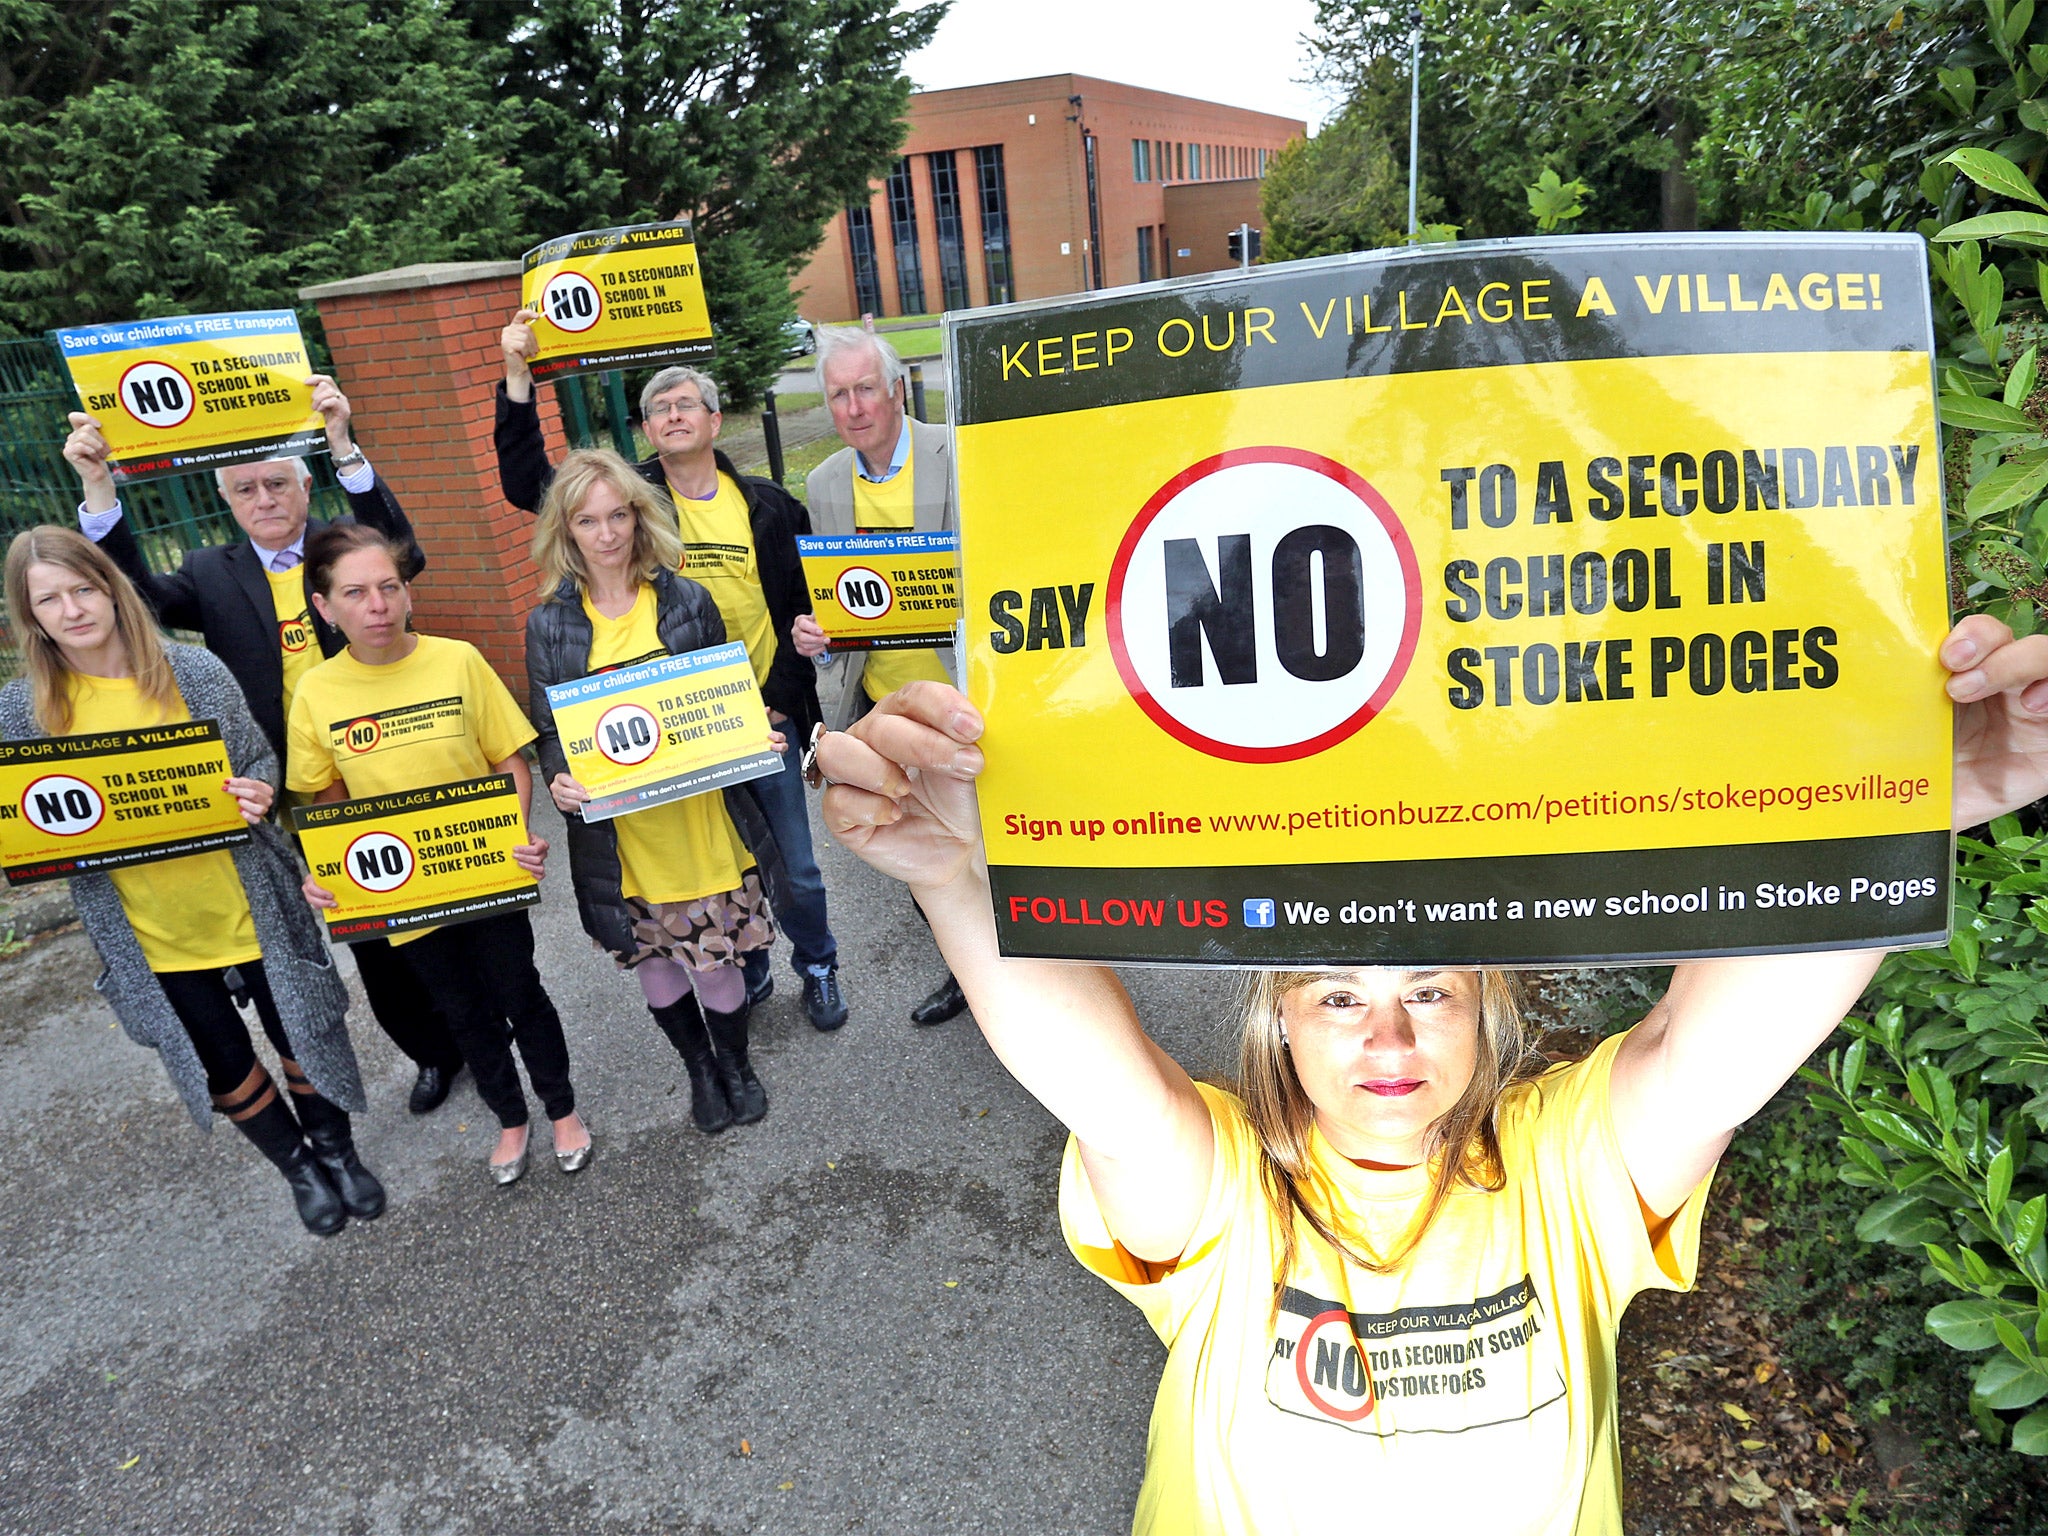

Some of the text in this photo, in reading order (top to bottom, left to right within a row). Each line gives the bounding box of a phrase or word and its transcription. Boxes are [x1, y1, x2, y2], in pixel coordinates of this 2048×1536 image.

[548, 244, 568, 256] OUR
[570, 235, 618, 251] VILLAGE
[620, 233, 629, 244] A
[630, 228, 684, 243] VILLAGE!
[600, 263, 695, 286] TO A SECONDARY
[551, 286, 593, 320] NO
[605, 285, 666, 304] SCHOOL IN
[608, 300, 683, 321] STOKE POGES
[63, 315, 294, 348] Save our children's FREE transport
[1001, 272, 1882, 381] KEEP OUR VILLAGE A VILLAGE!
[191, 351, 302, 376] TO A SECONDARY
[88, 377, 184, 415] SAY NO
[197, 373, 270, 395] SCHOOL IN
[203, 389, 292, 414] STOKE POGES
[1440, 445, 1920, 530] TO A SECONDARY
[799, 539, 825, 551] Save
[826, 541, 843, 550] our
[844, 537, 895, 550] children's
[896, 535, 927, 548] FREE
[891, 570, 907, 582] TO
[908, 570, 917, 581] A
[1444, 540, 1766, 623] SCHOOL IN
[814, 580, 884, 608] SAY NO
[895, 583, 955, 598] SCHOOL IN
[899, 599, 935, 612] STOKE
[989, 524, 1365, 688] SAY NO
[284, 628, 305, 646] NO
[549, 644, 744, 703] Save our children's FREE transport
[1446, 626, 1839, 710] STOKE POGES
[657, 679, 753, 713] TO A SECONDARY
[382, 722, 390, 730] TO
[397, 712, 435, 726] SECONDARY
[437, 708, 462, 718] SCHOOL
[662, 702, 726, 730] SCHOOL IN
[19, 743, 54, 757] OUR
[56, 737, 122, 754] VILLAGE
[126, 736, 139, 746] A
[139, 725, 210, 744] VILLAGE!
[334, 726, 374, 746] SAY NO
[382, 722, 434, 739] IN STOKE POGES
[569, 716, 652, 756] SAY NO
[667, 715, 745, 747] STOKE POGES
[102, 759, 225, 788] TO A SECONDARY
[35, 789, 93, 825] NO
[108, 783, 189, 806] SCHOOL IN
[305, 780, 507, 822] KEEP OUR VILLAGE A VILLAGE!
[1004, 774, 1930, 841] Sign up online www.petitionbuzz.com/petitions/stokepogesvillage
[114, 797, 211, 822] STOKE POGES
[413, 813, 519, 843] TO A SECONDARY
[418, 836, 488, 861] SCHOOL IN
[316, 845, 404, 881] SAY NO
[422, 850, 507, 877] STOKE POGES
[331, 922, 371, 937] FOLLOW
[372, 920, 387, 930] US
[396, 917, 409, 926] We
[427, 910, 444, 920] want
[450, 906, 466, 915] new
[465, 899, 489, 913] school
[489, 899, 497, 907] in
[496, 896, 517, 906] Stoke
[516, 890, 538, 903] Poges
[1009, 896, 1164, 927] FOLLOW
[1177, 899, 1229, 928] US
[1283, 900, 1330, 925] We
[1426, 896, 1498, 923] want
[1506, 902, 1524, 920] a
[1534, 897, 1597, 918] new
[1604, 887, 1708, 917] school
[1718, 885, 1745, 911] in
[1755, 881, 1841, 909] Stoke
[1849, 876, 1937, 905] Poges
[1367, 1319, 1398, 1335] KEEP
[1399, 1315, 1430, 1329] OUR
[1433, 1314, 1474, 1328] VILLAG
[1472, 1308, 1482, 1321] A
[1275, 1337, 1367, 1397] AY NO
[1369, 1351, 1390, 1372] TO
[1393, 1348, 1403, 1368] A
[1405, 1337, 1484, 1367] SECONDRY
[1388, 1374, 1439, 1397] STOKE
